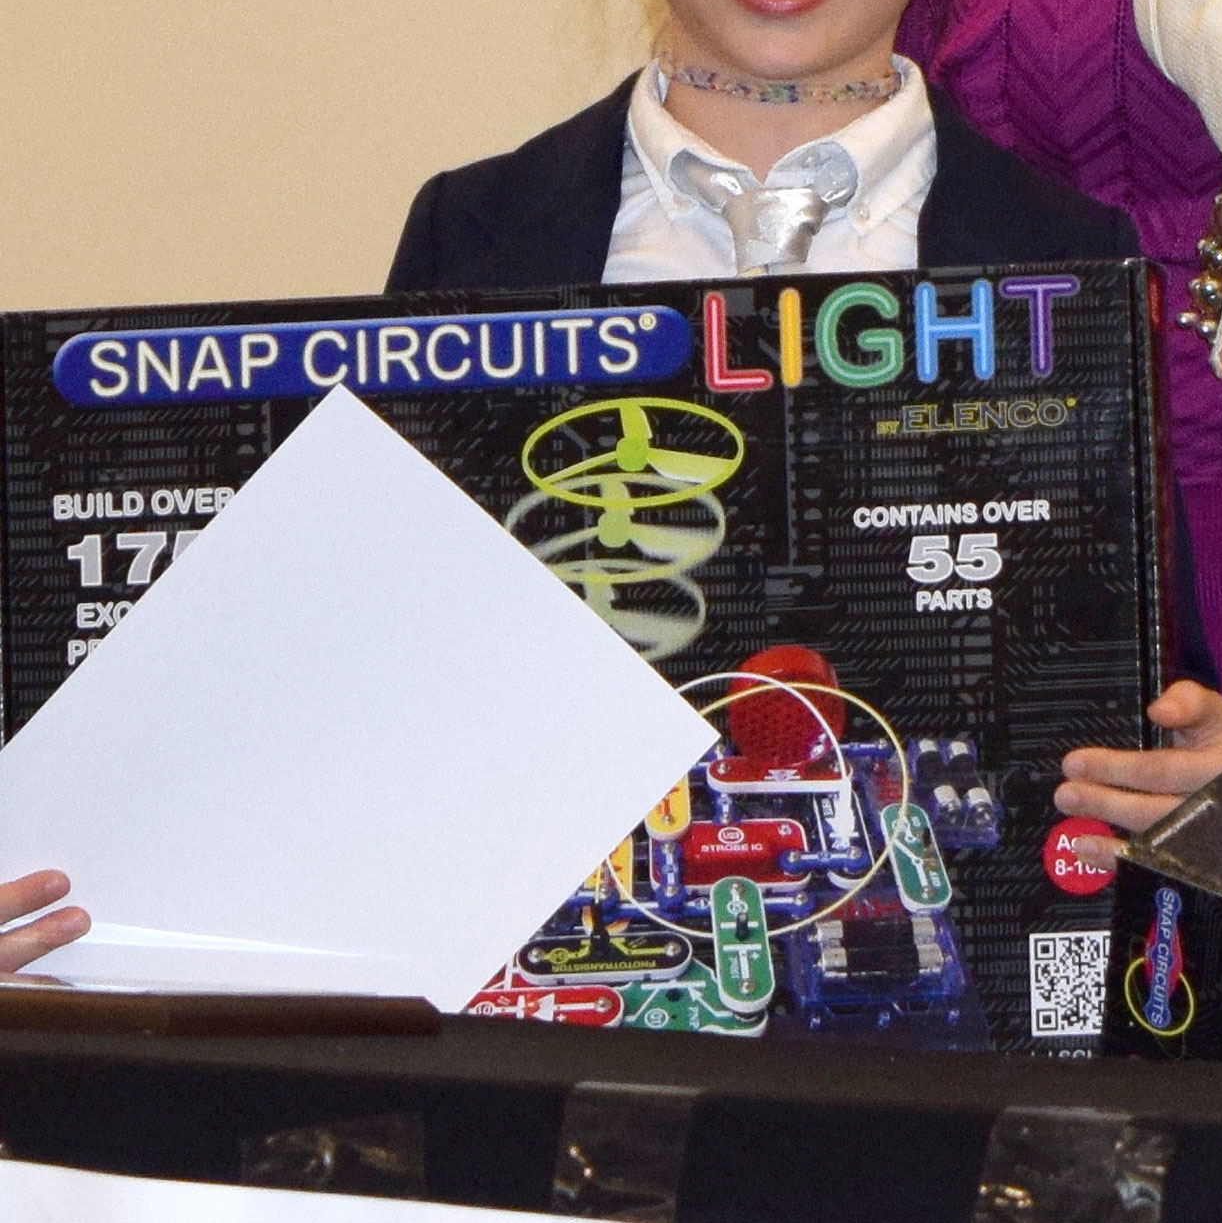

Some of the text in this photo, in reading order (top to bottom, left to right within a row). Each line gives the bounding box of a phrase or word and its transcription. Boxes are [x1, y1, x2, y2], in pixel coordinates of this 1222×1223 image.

[89, 333, 279, 397] SNAP
[704, 276, 1080, 392] LIGHT
[53, 490, 145, 520] BUILD
[853, 499, 1050, 528] CONTAINS OVER
[906, 533, 1003, 583] 55
[916, 588, 993, 612] PARTS
[701, 843, 750, 853] STROBE
[551, 959, 656, 973] PHOTOTRANSISTOR
[1151, 890, 1174, 1025] SNAP CIRCUITS
